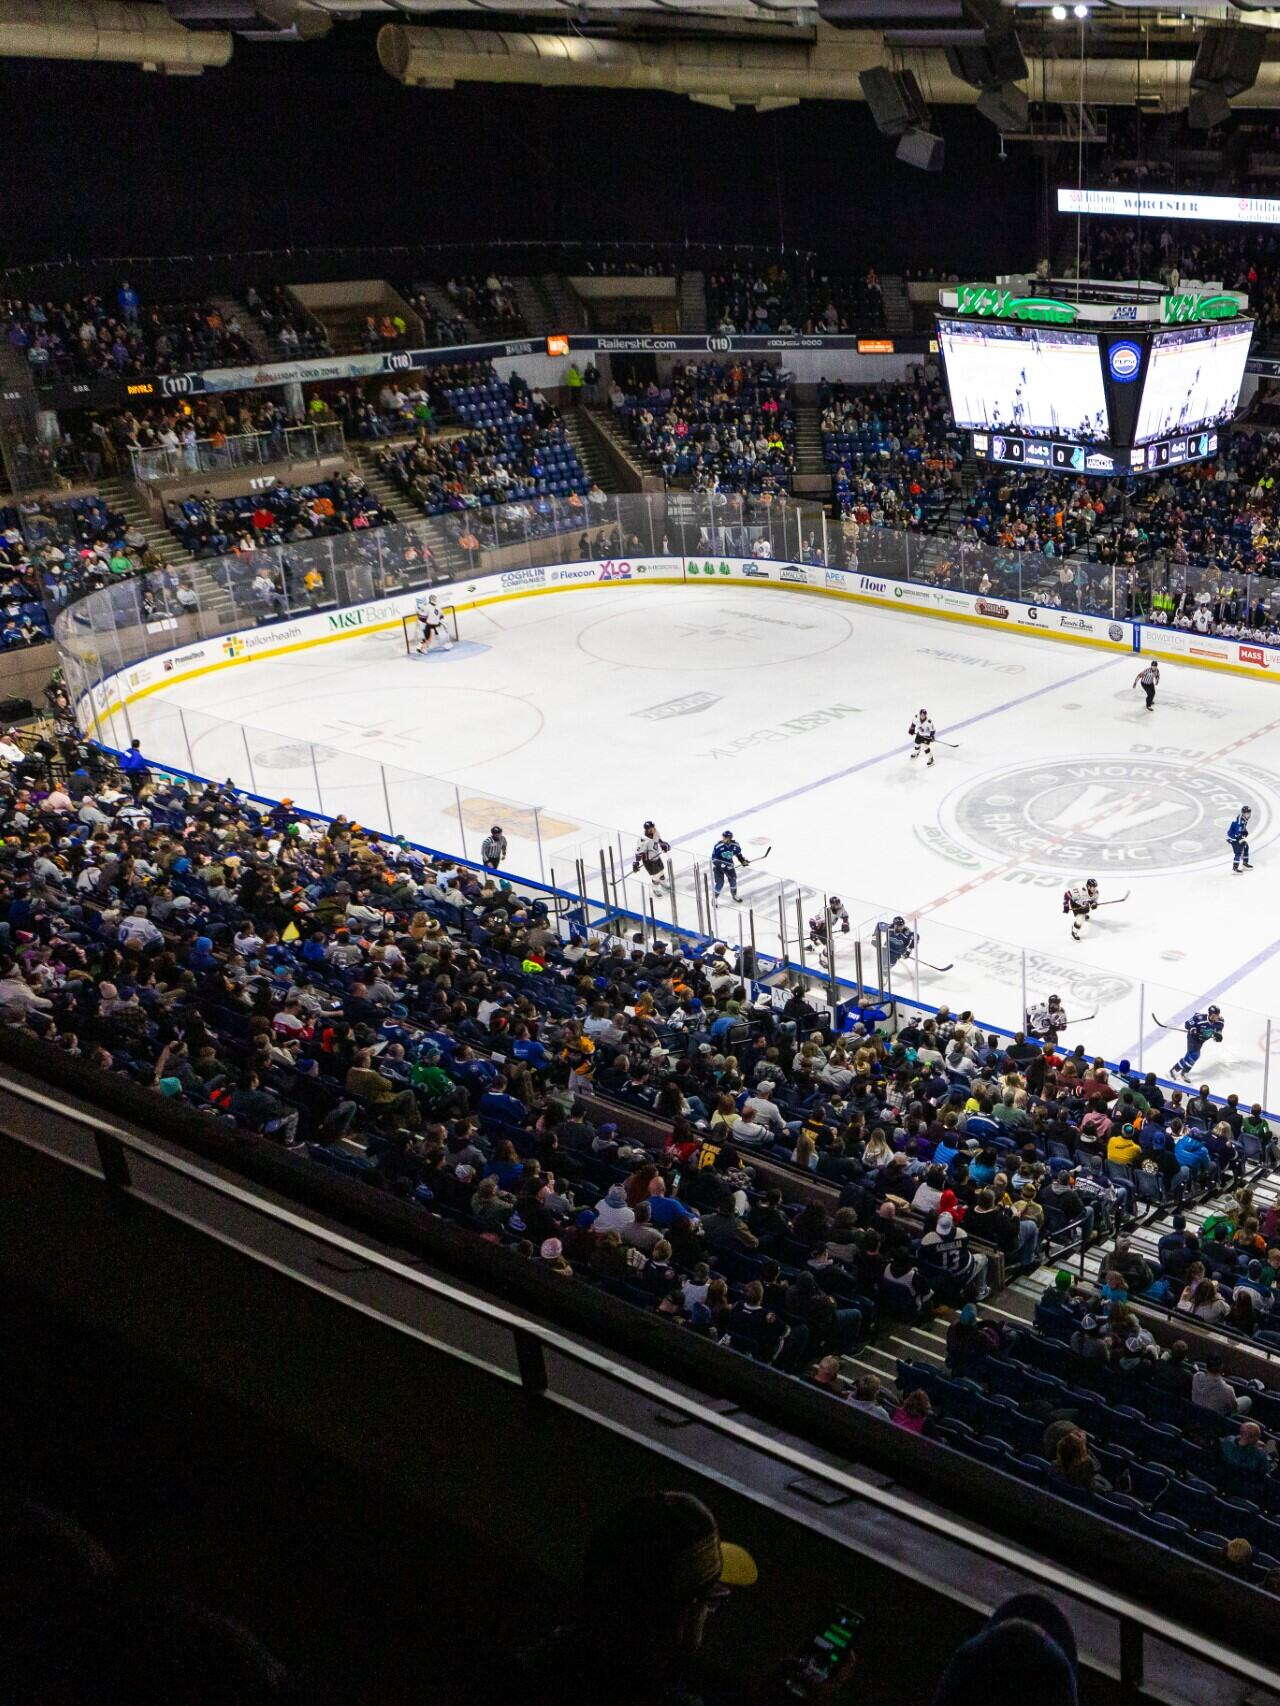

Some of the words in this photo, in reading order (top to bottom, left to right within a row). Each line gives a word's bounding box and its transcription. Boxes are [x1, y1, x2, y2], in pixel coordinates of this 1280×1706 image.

[597, 338, 677, 349] RailersHC.com
[711, 337, 728, 350] 119
[167, 374, 188, 393] 117
[1012, 444, 1020, 457] 0
[1057, 450, 1065, 463] 0
[500, 567, 546, 583] COGHLIN
[560, 569, 595, 580] Flexcon
[599, 560, 631, 580] XLO
[860, 577, 887, 593] flow
[328, 607, 365, 631] M&T
[364, 602, 401, 624] Bank
[1240, 649, 1263, 660] MASS
[1265, 653, 1280, 665] LIVE
[1100, 846, 1153, 860] HC
